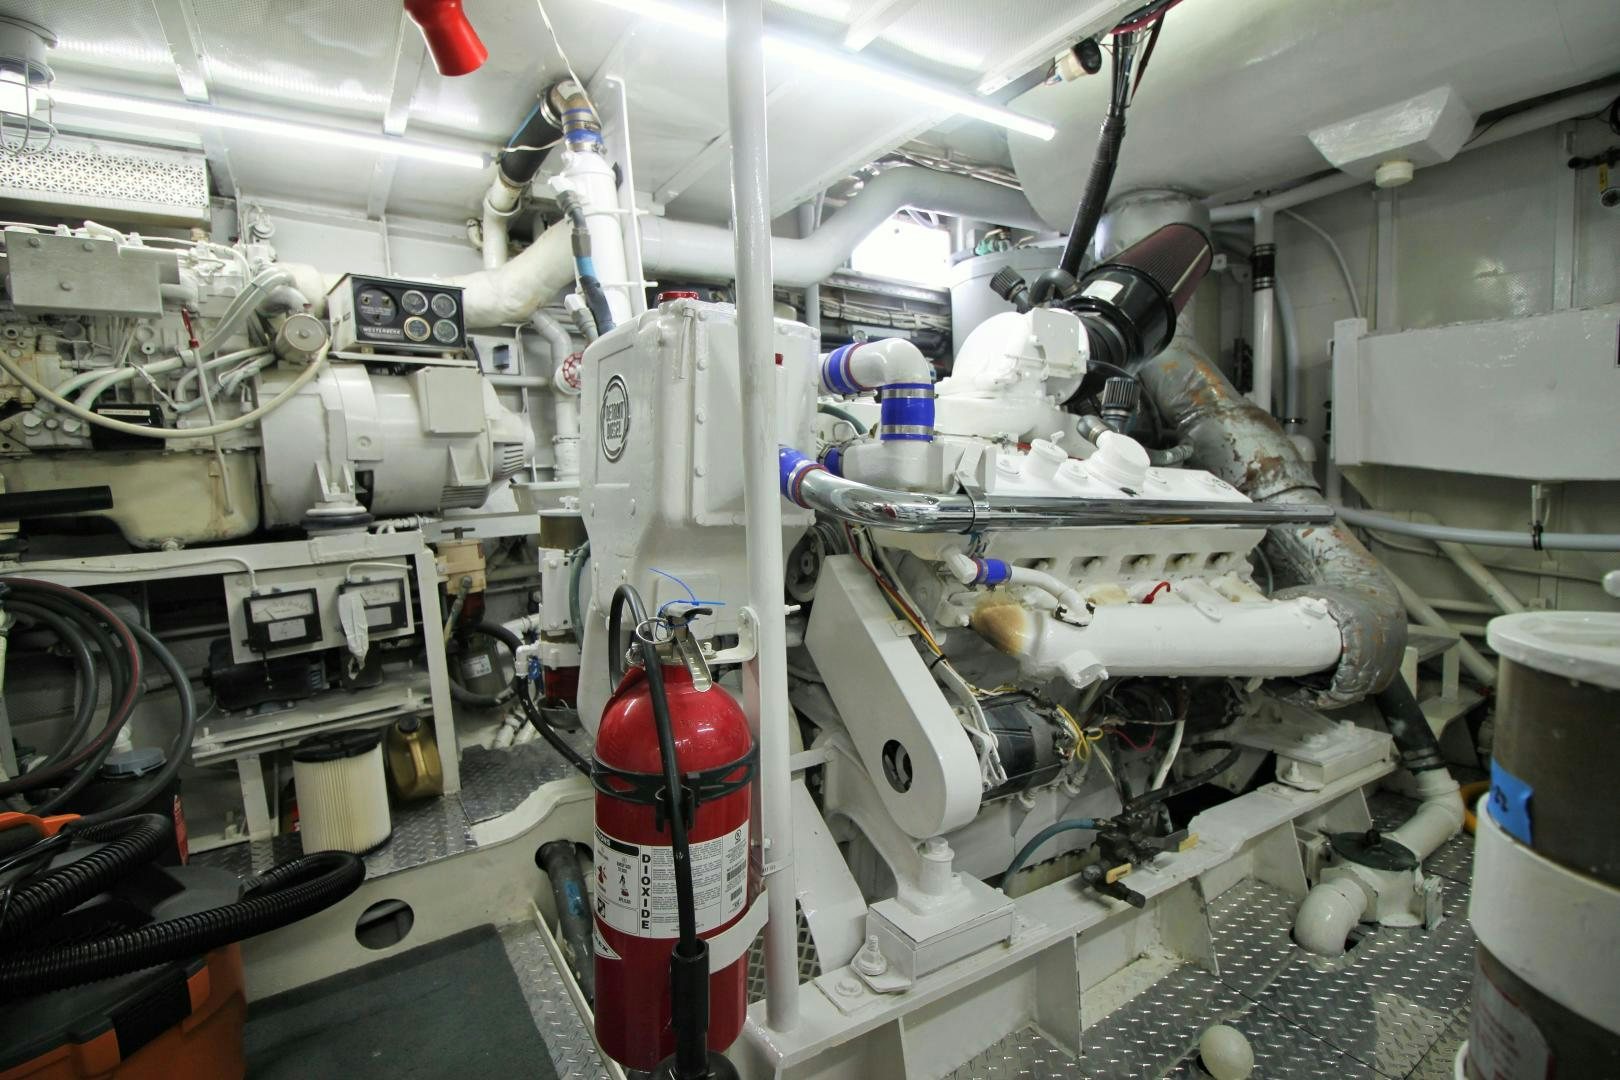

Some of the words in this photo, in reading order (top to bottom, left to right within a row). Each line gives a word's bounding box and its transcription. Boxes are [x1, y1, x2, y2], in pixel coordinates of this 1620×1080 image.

[606, 402, 623, 421] DETROIT
[607, 421, 621, 440] DIESEL
[641, 854, 651, 930] DIOXIDE
